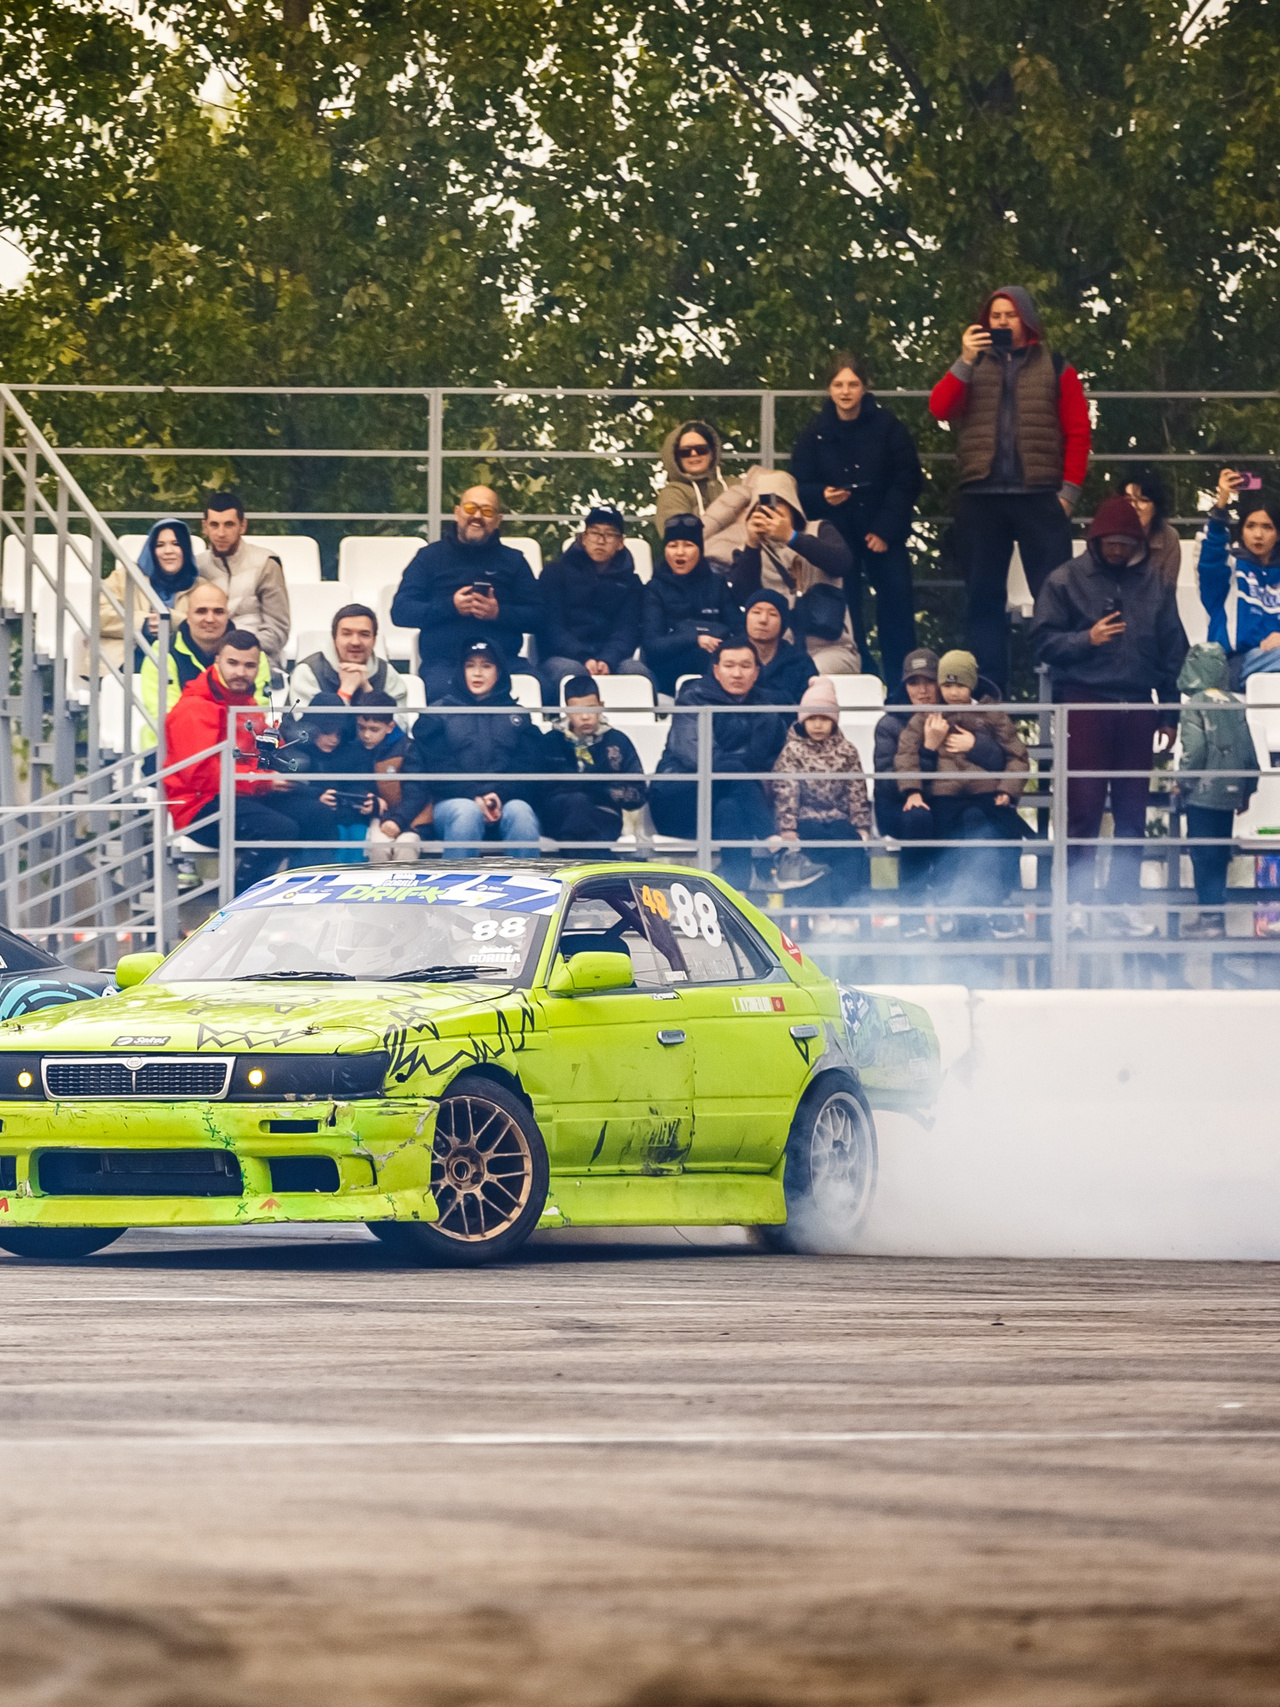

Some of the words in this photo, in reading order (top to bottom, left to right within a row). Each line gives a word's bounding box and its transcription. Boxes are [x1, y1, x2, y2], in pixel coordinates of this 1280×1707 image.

[642, 884, 670, 920] 48
[670, 882, 723, 948] 88
[472, 916, 528, 942] 88
[468, 953, 521, 963] GORILLA
